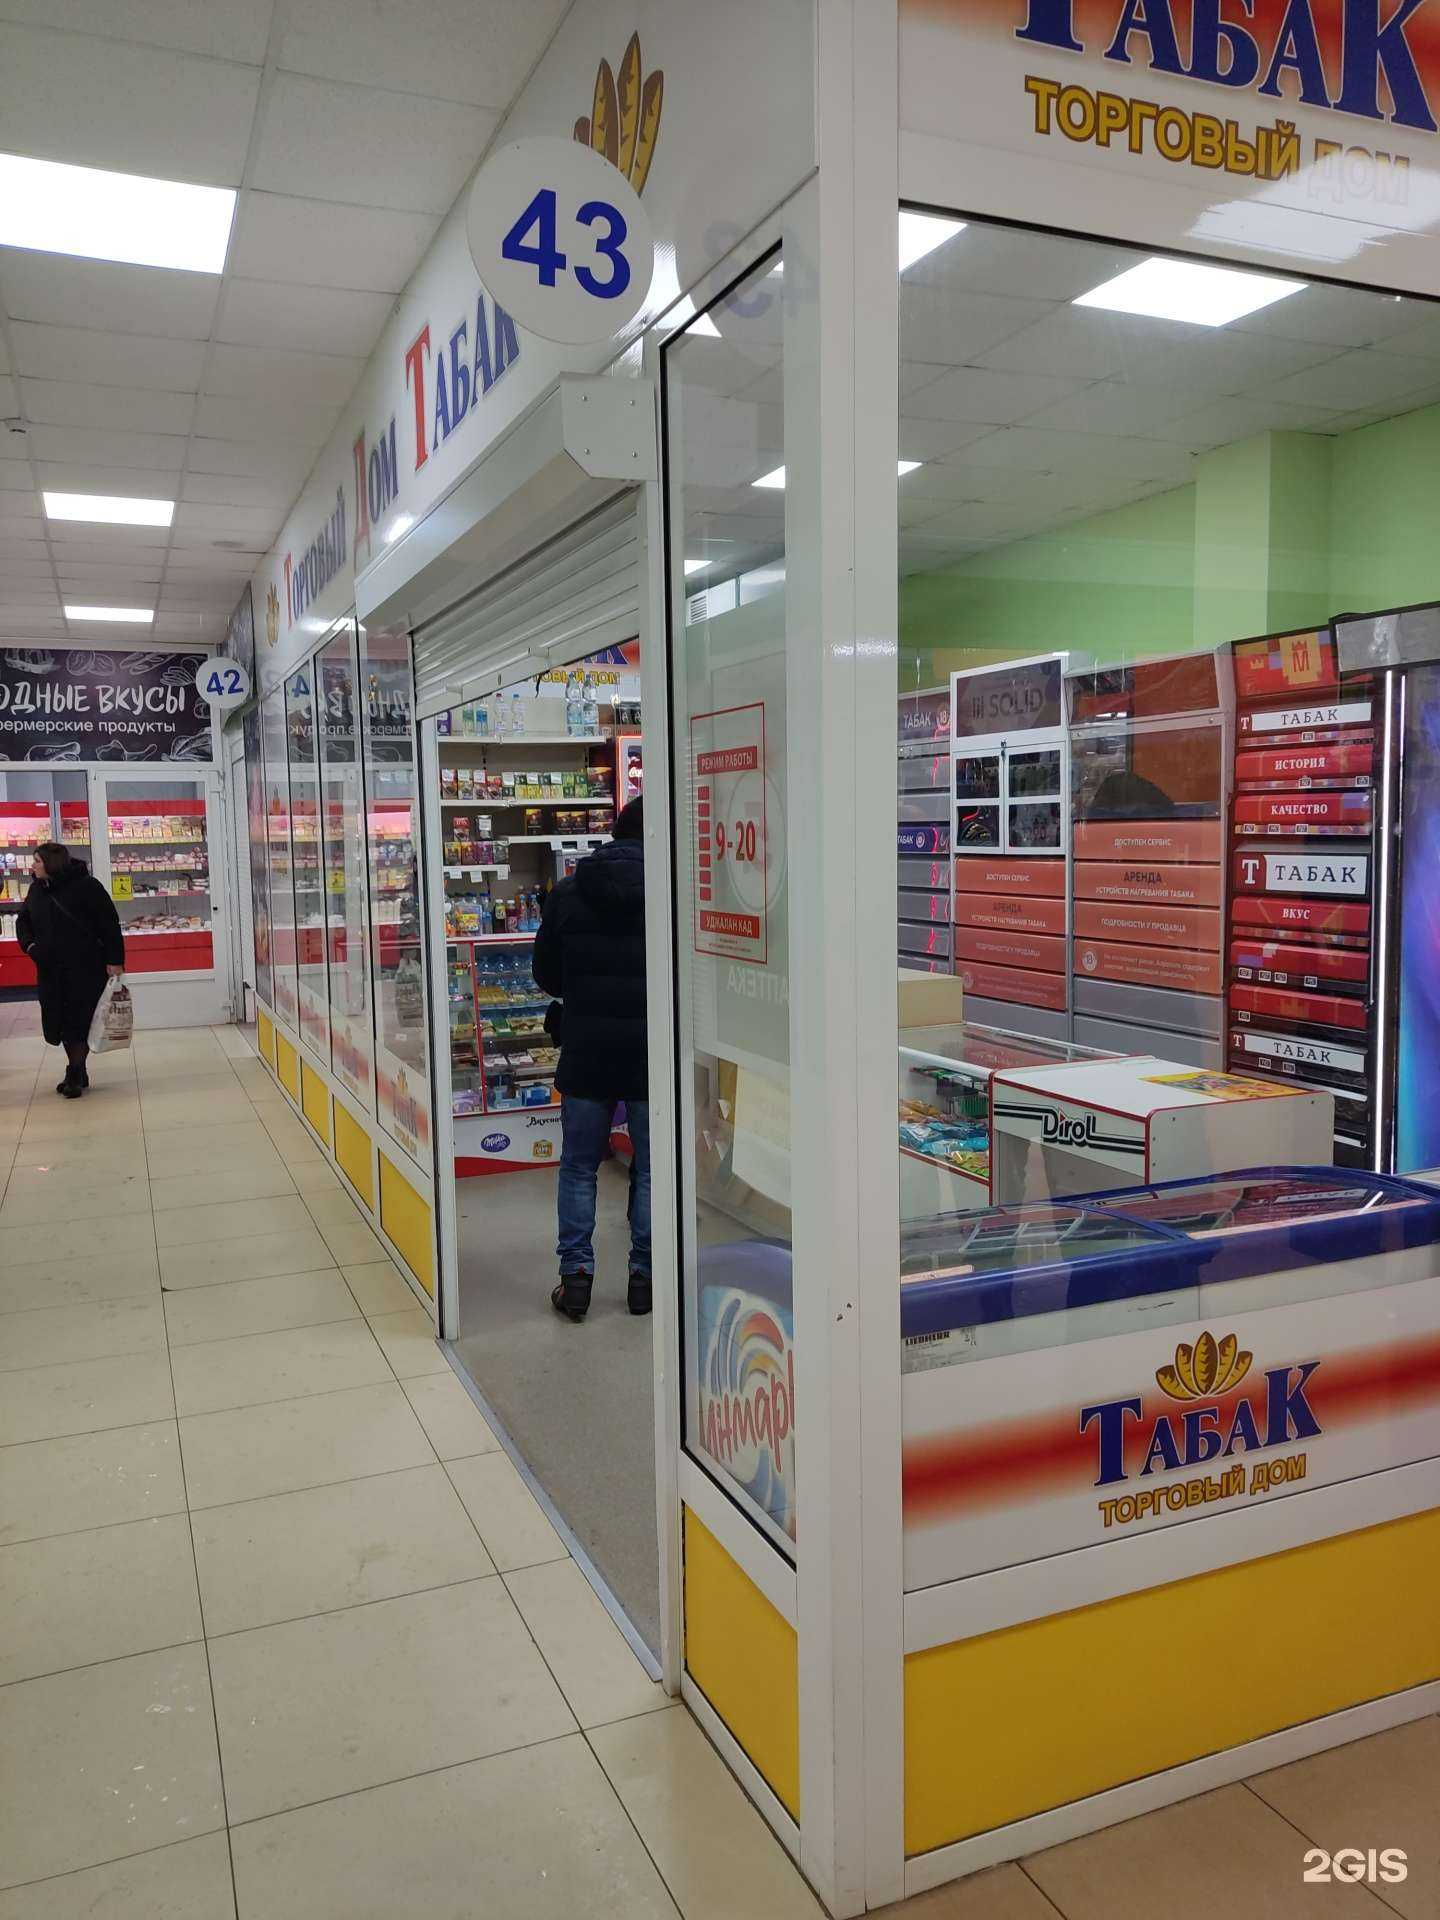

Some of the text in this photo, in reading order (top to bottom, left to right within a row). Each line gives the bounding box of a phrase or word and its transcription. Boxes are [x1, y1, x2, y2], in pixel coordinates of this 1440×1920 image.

[1024, 75, 1300, 181] ТОРГОВЫЙ
[501, 189, 631, 299] 43
[353, 417, 399, 574] ДОМ
[205, 668, 245, 697] 42
[94, 685, 185, 716] ВКУСЫ
[989, 688, 1044, 719] SOLID
[904, 711, 931, 729] ТАБАК
[1281, 709, 1339, 726] ТАБАК
[98, 721, 177, 736] продукты
[701, 751, 753, 771] РЕЖИМ РАБОТЫ
[1275, 757, 1326, 771] ИСТОРИЯ
[1271, 803, 1328, 816] КАЧЕСТВО
[1123, 871, 1163, 885] АРЕНДА
[1275, 864, 1357, 884] ТАБАК
[1282, 908, 1311, 919] ВКУС
[1273, 1042, 1331, 1063] ТАБАК
[1041, 1108, 1097, 1146] Dirol
[1080, 1362, 1322, 1487] ТАБАК
[1099, 1453, 1307, 1528] ТОРГОВЫЙ ДОМ
